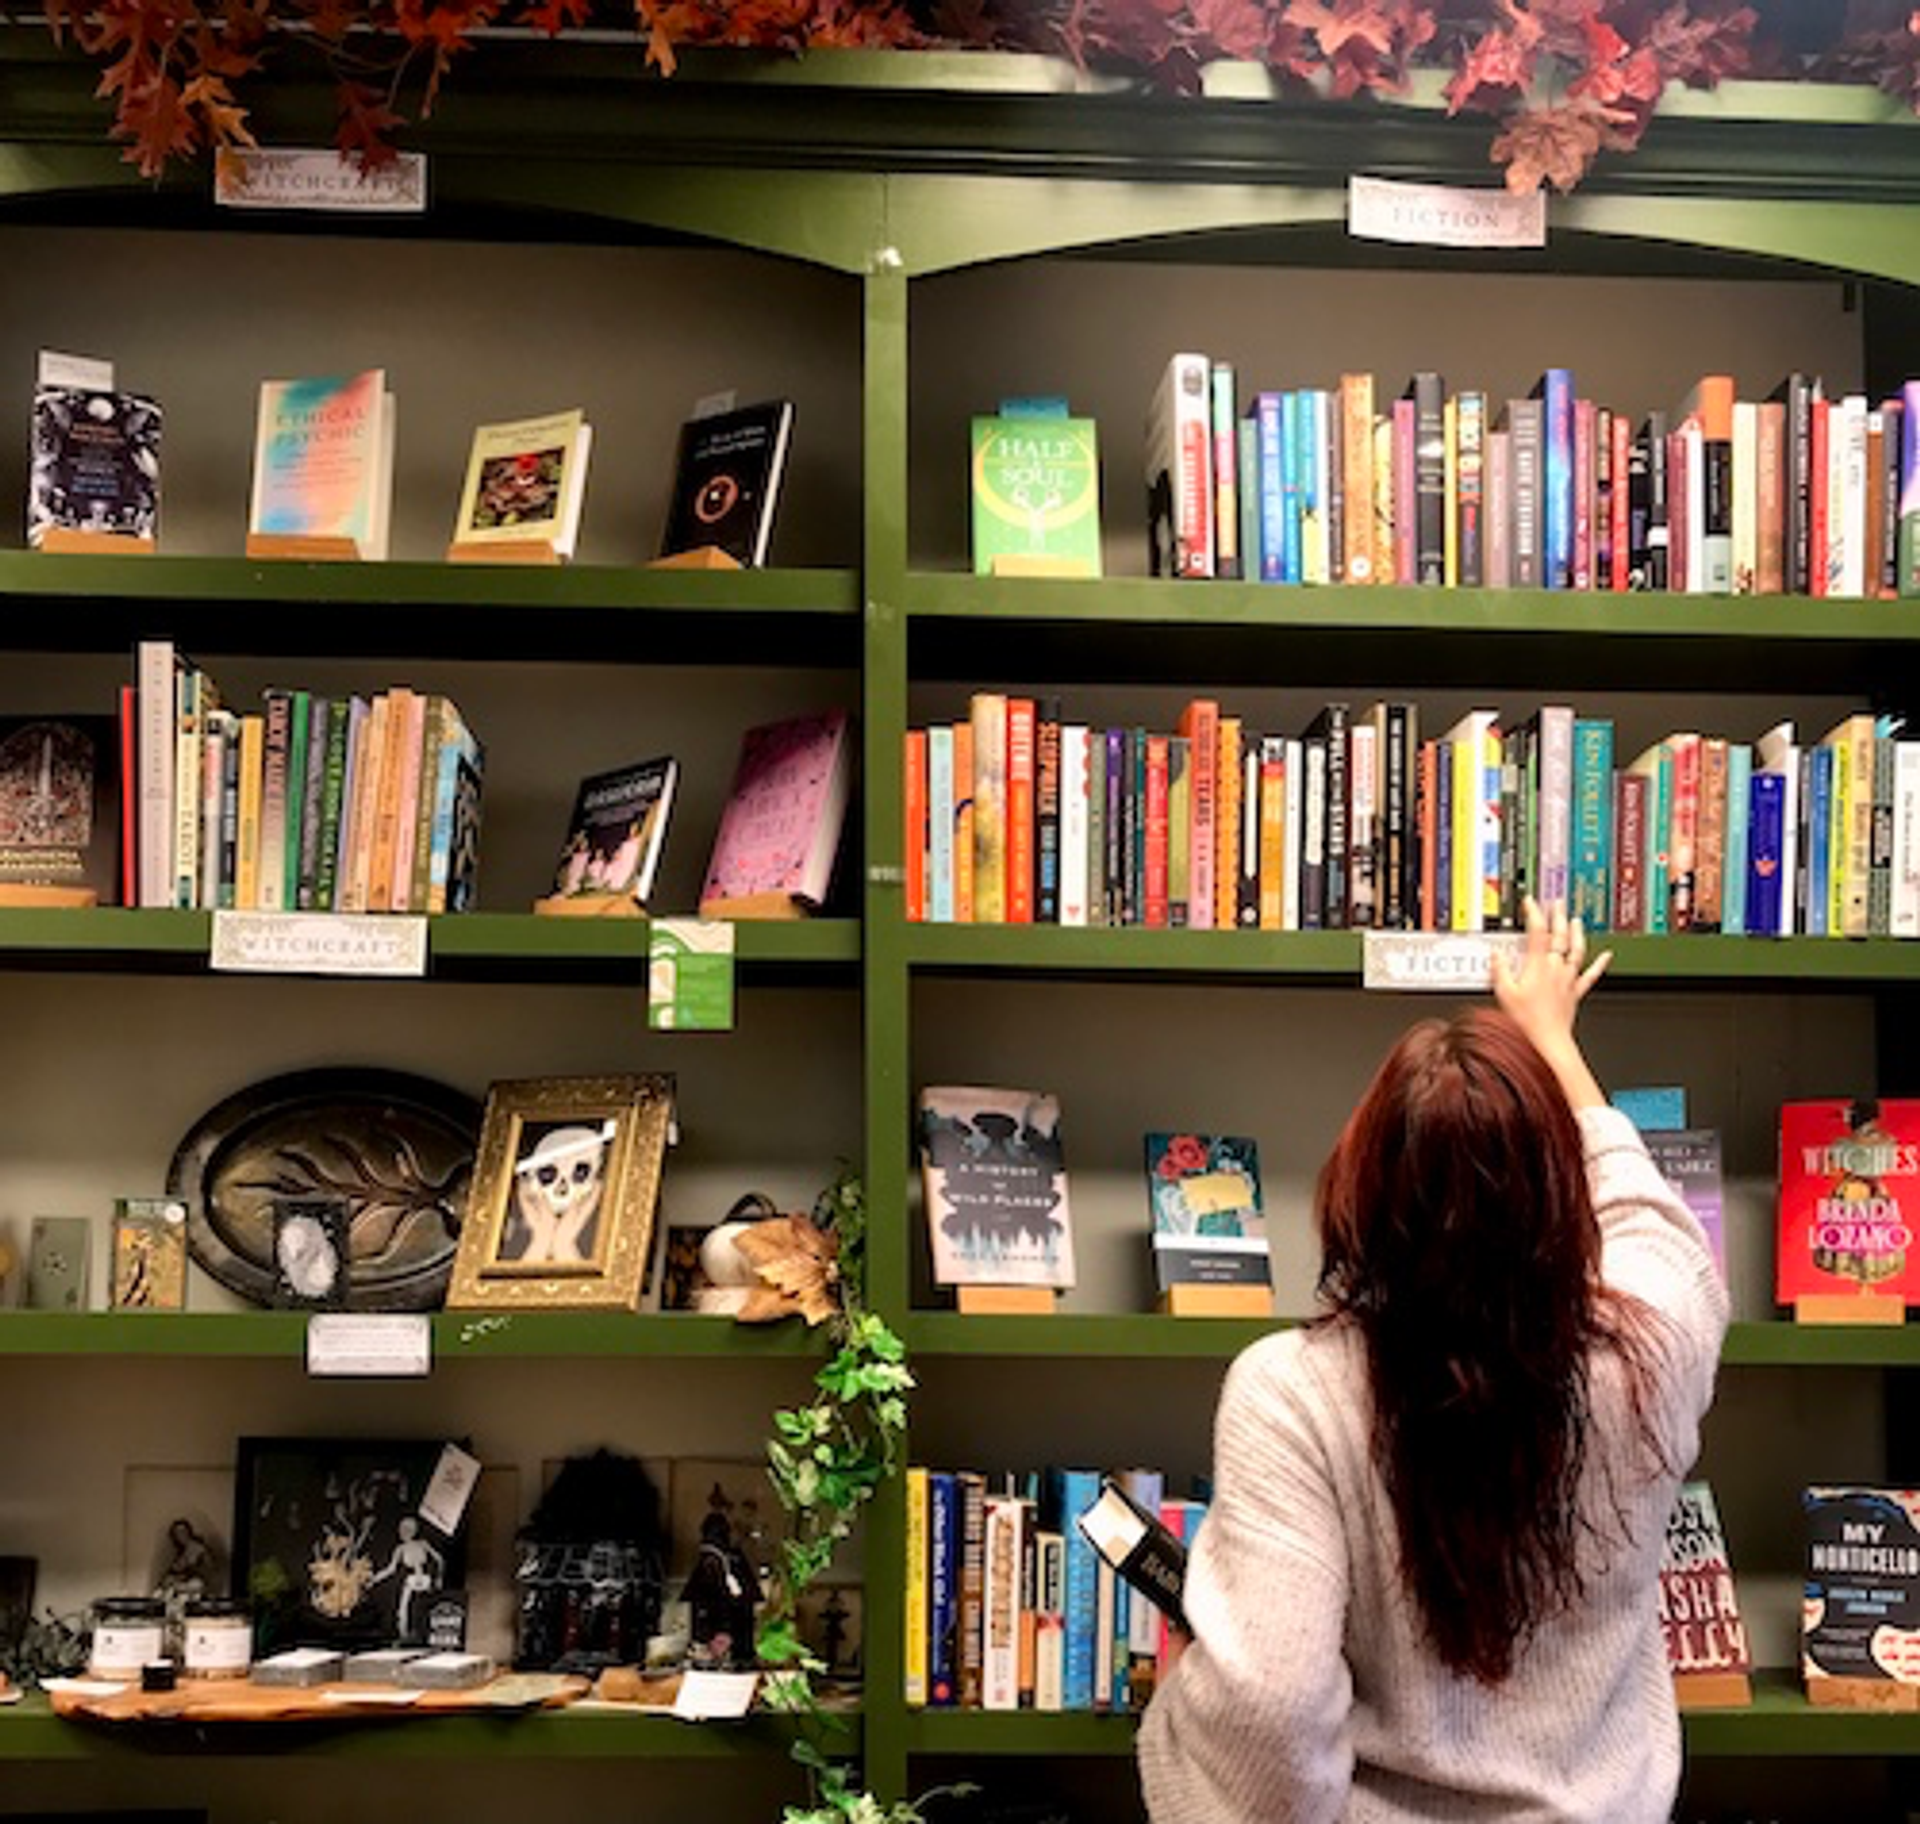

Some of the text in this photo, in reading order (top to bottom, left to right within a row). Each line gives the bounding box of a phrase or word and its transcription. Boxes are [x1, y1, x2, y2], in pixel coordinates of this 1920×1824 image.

[1392, 207, 1500, 229] FICTION
[275, 407, 366, 426] ETHICAL
[275, 423, 366, 444] PSYCHIC
[1000, 438, 1075, 459] HALF
[1001, 467, 1072, 489] SOUL
[243, 936, 398, 955] WITCHCRAFT
[959, 1163, 1039, 1177] A HISTORY
[1803, 1146, 1919, 1176] WITCHES
[949, 1193, 1053, 1208] WILD PLACES
[1816, 1198, 1902, 1222] BRENDA
[1809, 1224, 1913, 1251] LOZANO
[1842, 1523, 1886, 1544] MY
[1812, 1545, 1919, 1575] MONTICELLO
